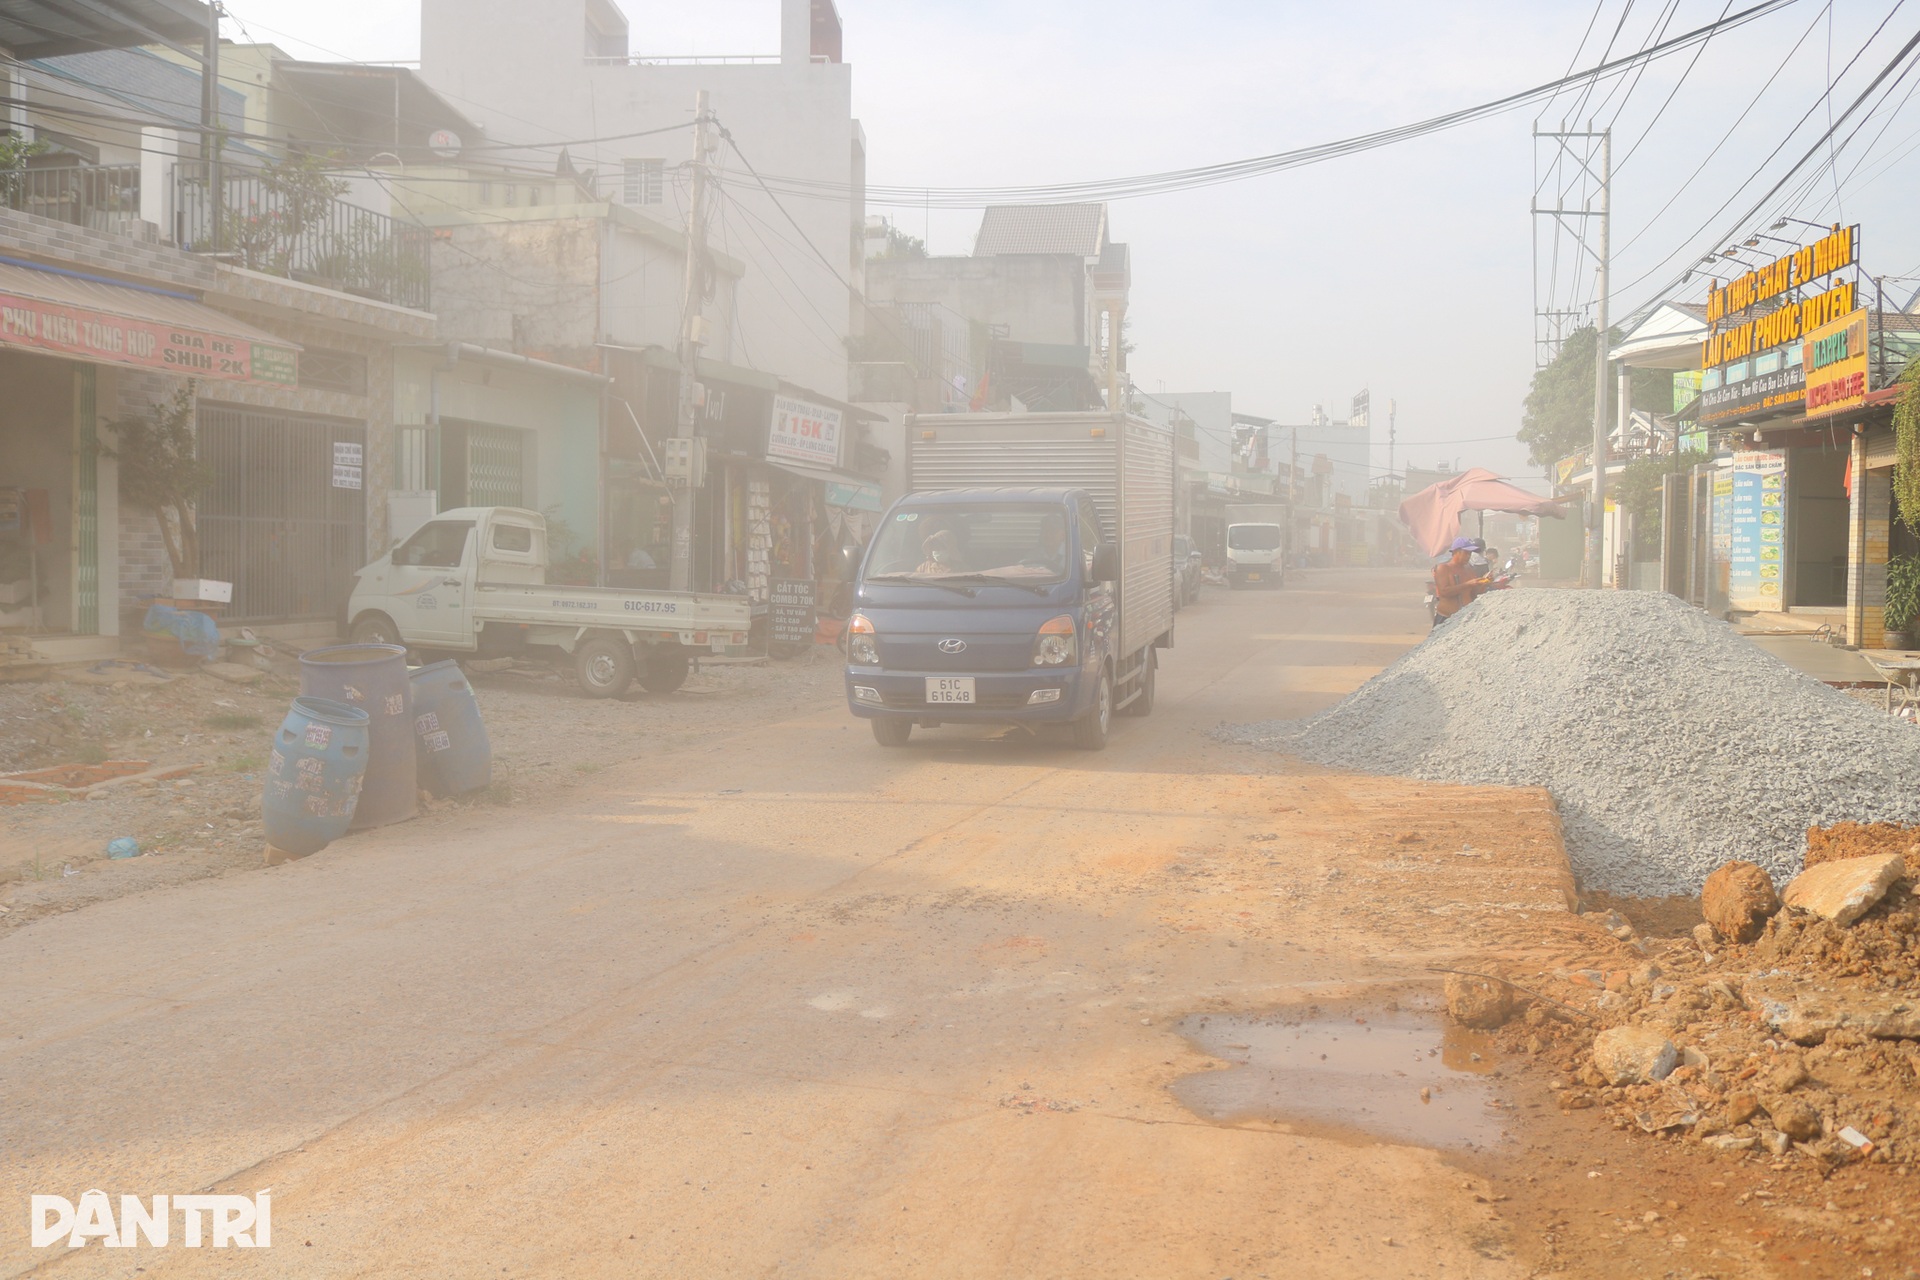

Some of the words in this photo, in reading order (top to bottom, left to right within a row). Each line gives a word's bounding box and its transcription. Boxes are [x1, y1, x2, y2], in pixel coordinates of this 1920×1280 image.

[1727, 270, 1756, 316] THỰC
[1757, 255, 1791, 301] CHAY
[1793, 245, 1812, 287] 20
[1814, 222, 1852, 278] MÓN
[1702, 322, 1722, 369] LẨU
[1724, 322, 1753, 362] CHAY
[1755, 298, 1800, 353] PHƯỚC
[1802, 277, 1853, 335] DUYÊN
[2, 306, 37, 342] PHỤ
[82, 316, 122, 353] TỔNG
[127, 330, 156, 360] HỢP
[219, 358, 246, 375] 2K
[791, 417, 823, 439] 15K
[777, 581, 792, 593] CẮT
[793, 582, 809, 594] TÓC
[624, 601, 676, 613] 61C-617.95
[770, 594, 798, 604] COMBO
[799, 595, 814, 605] 70K
[940, 679, 961, 690] 61C
[931, 691, 970, 702] 616.48
